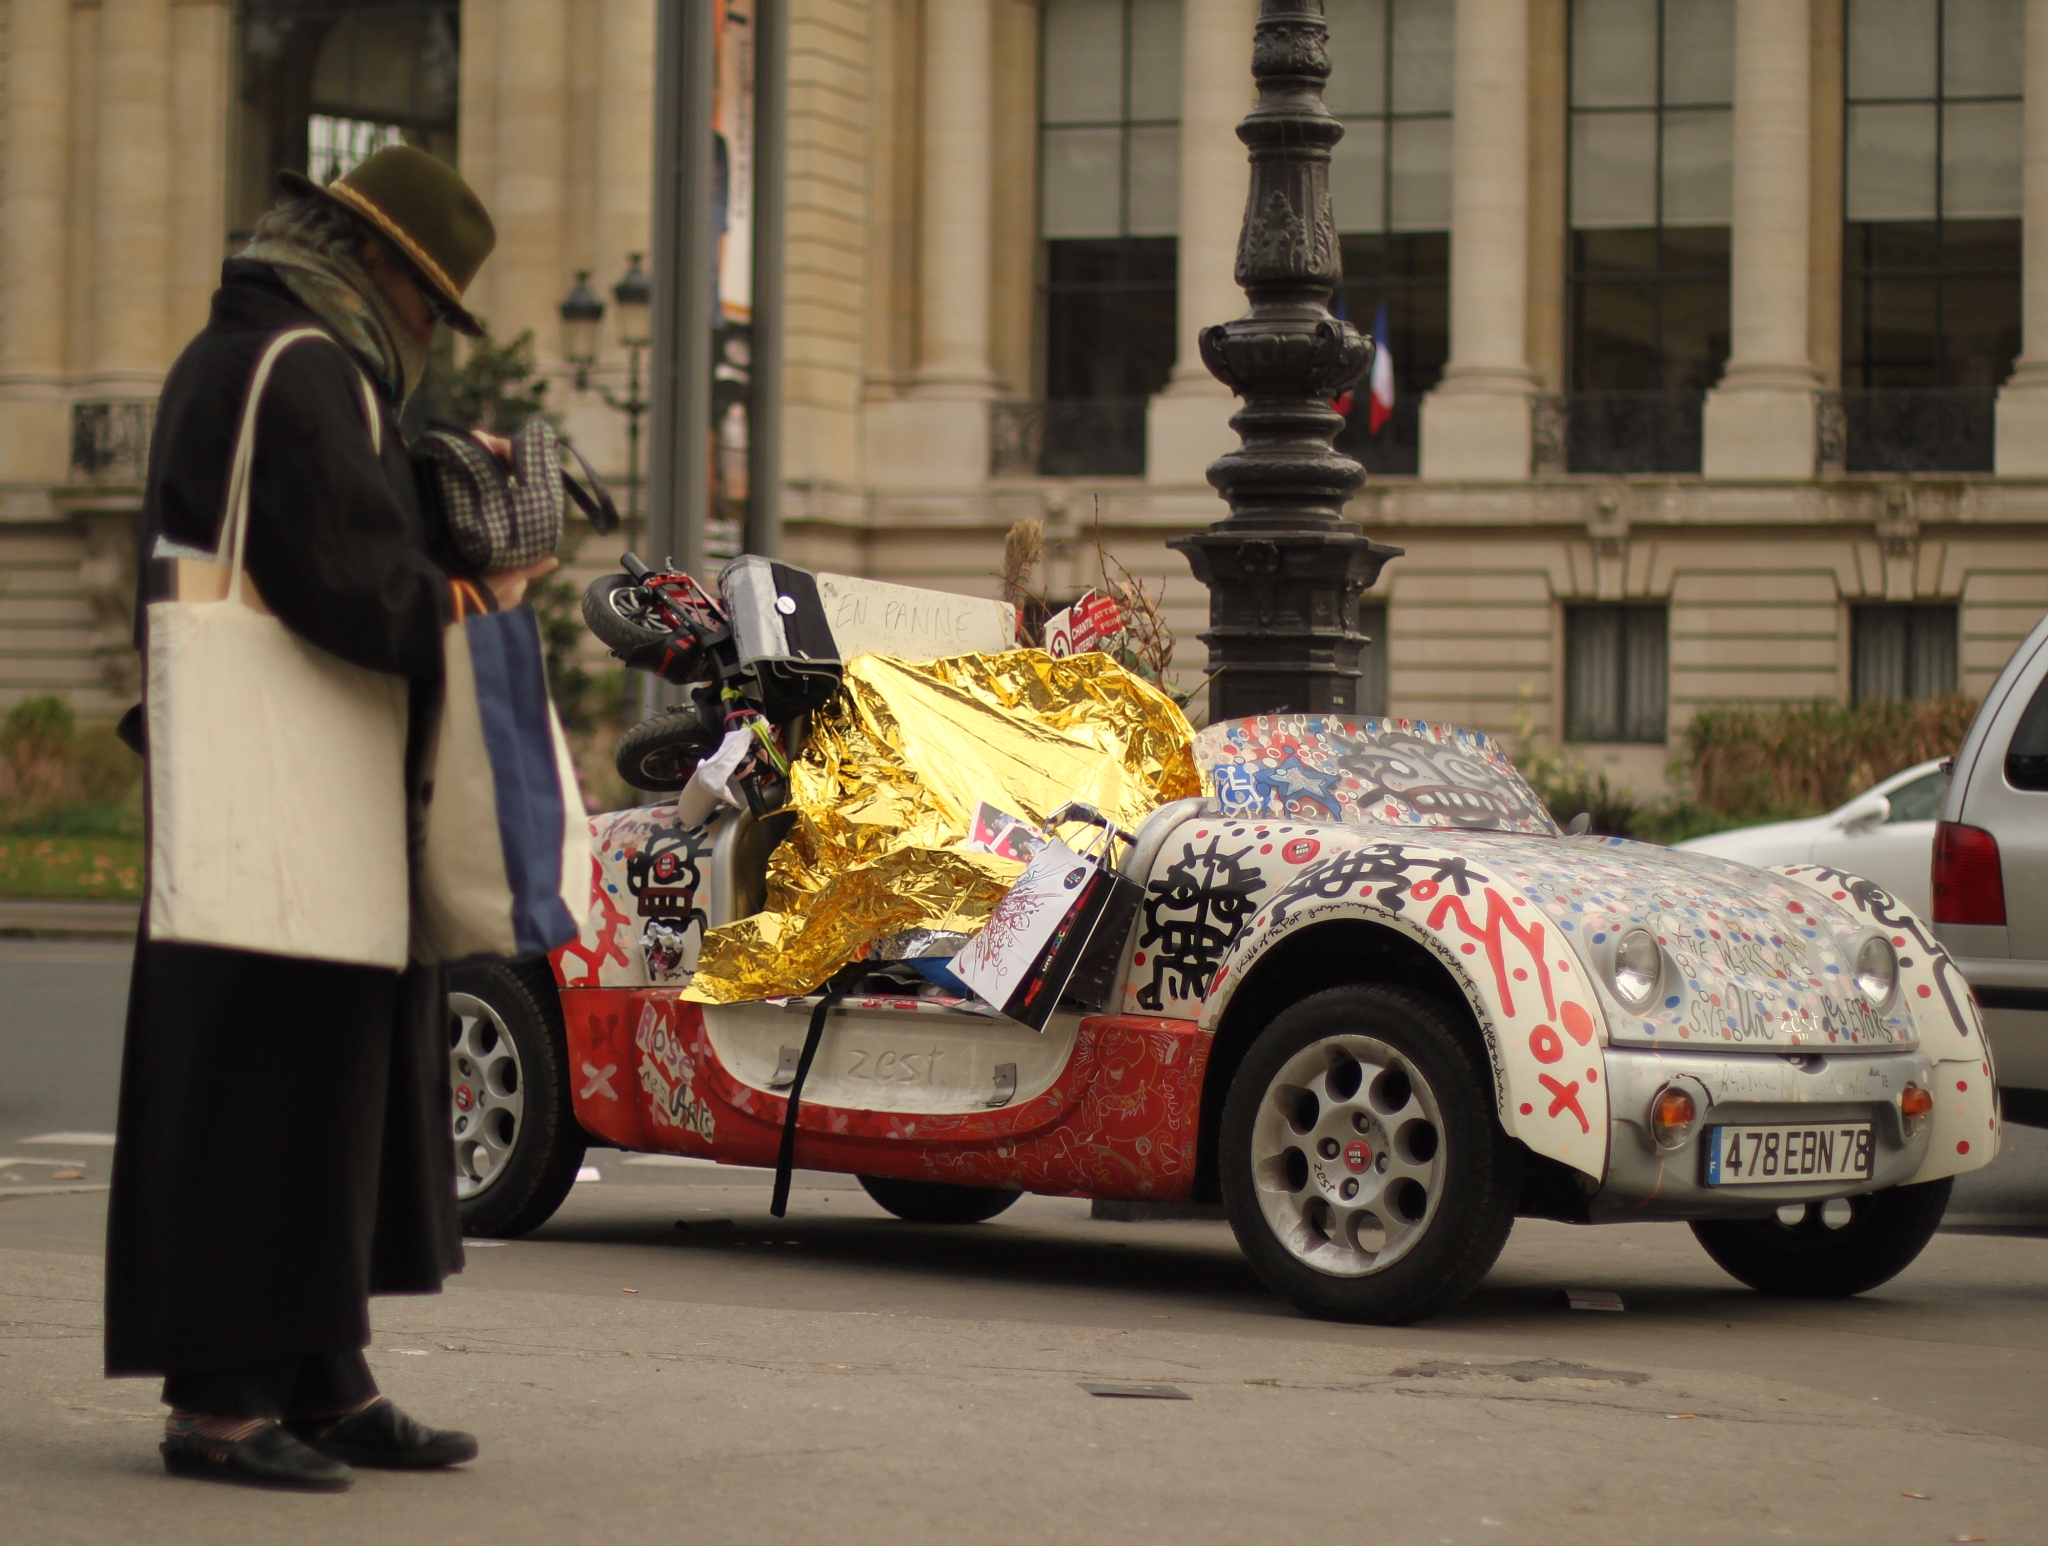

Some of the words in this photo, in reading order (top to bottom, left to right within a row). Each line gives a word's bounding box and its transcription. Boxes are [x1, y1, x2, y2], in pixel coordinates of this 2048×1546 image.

[836, 594, 868, 628] EN
[885, 601, 973, 643] PANNE
[1050, 925, 1069, 955] POSCA
[638, 1005, 694, 1083] Rose
[847, 1043, 945, 1089] zest
[1709, 1161, 1717, 1175] F
[1725, 1132, 1780, 1177] 478
[1783, 1131, 1835, 1176] EBN
[1840, 1129, 1870, 1173] 78
[1313, 1162, 1336, 1194] zest
